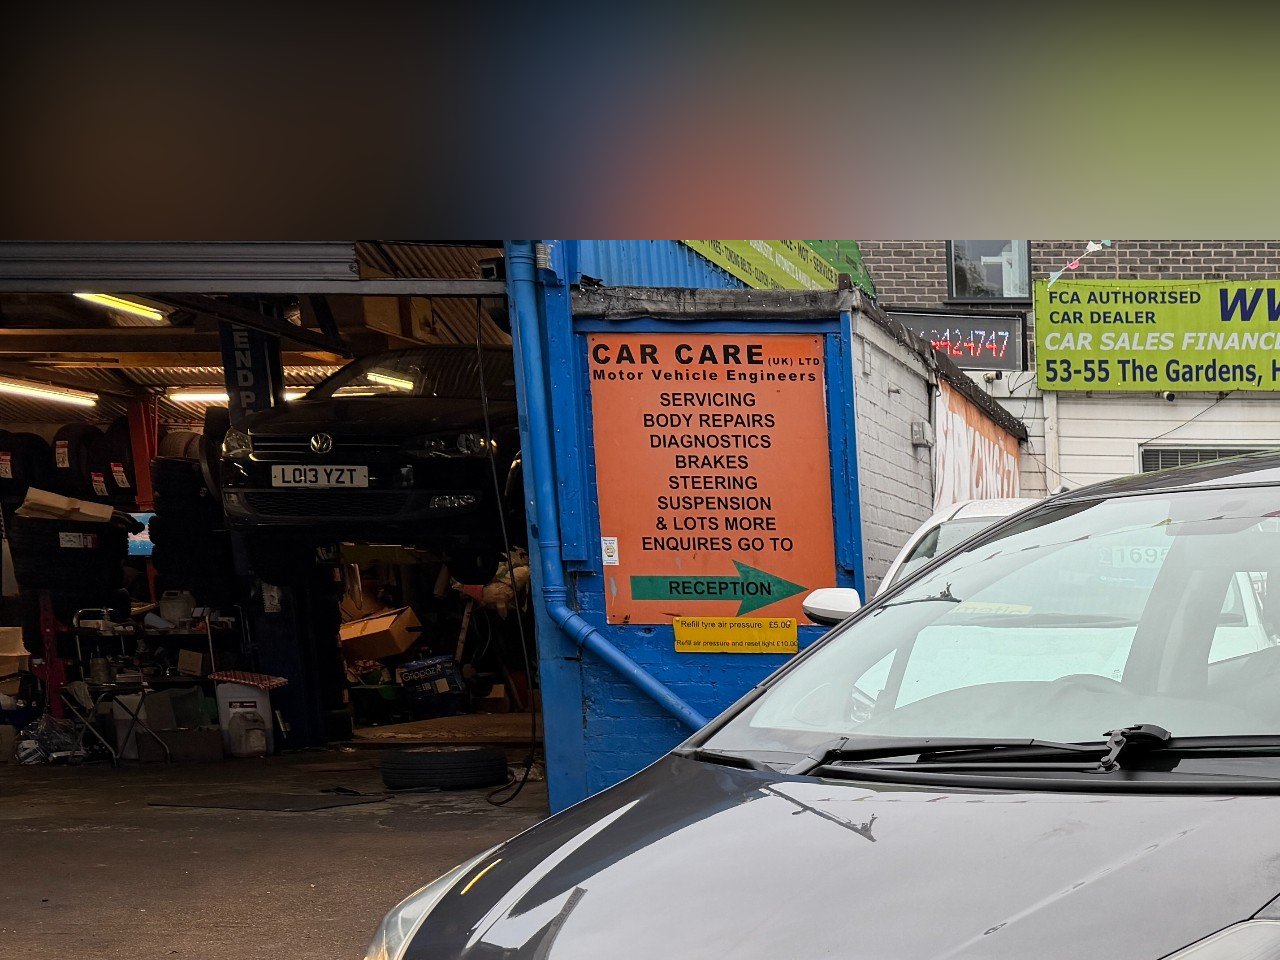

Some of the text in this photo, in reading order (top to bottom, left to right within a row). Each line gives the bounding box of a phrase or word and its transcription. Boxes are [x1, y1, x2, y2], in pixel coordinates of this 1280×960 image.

[1049, 290, 1201, 305] FCA AUTHORISED
[1049, 311, 1156, 324] CAR DEALER
[1045, 332, 1092, 350] CAR
[1099, 332, 1174, 350] SALES
[592, 343, 820, 366] CAR CARE (UK) LTD
[593, 369, 817, 383] Motor Vehicle Engineers
[1046, 360, 1110, 382] 53-55
[1117, 359, 1158, 382] The
[1165, 359, 1263, 386] Gardens,
[659, 392, 756, 407] SERVICING
[643, 414, 776, 428] BODY REPAIRS
[649, 434, 772, 449] DIAGNOSTICS
[675, 455, 749, 469] BRAKES
[323, 468, 356, 484] YZT
[668, 475, 758, 490] STEERING
[657, 496, 772, 511] SUSPENSION
[655, 516, 776, 531] & LOTS MORE
[642, 537, 793, 551] ENQUIRES GO TO
[668, 580, 772, 596] RECEPTION
[680, 620, 700, 628] Refill
[701, 620, 716, 629] tyre
[717, 620, 728, 628] air
[702, 640, 730, 648] pressure
[761, 640, 775, 648] light
